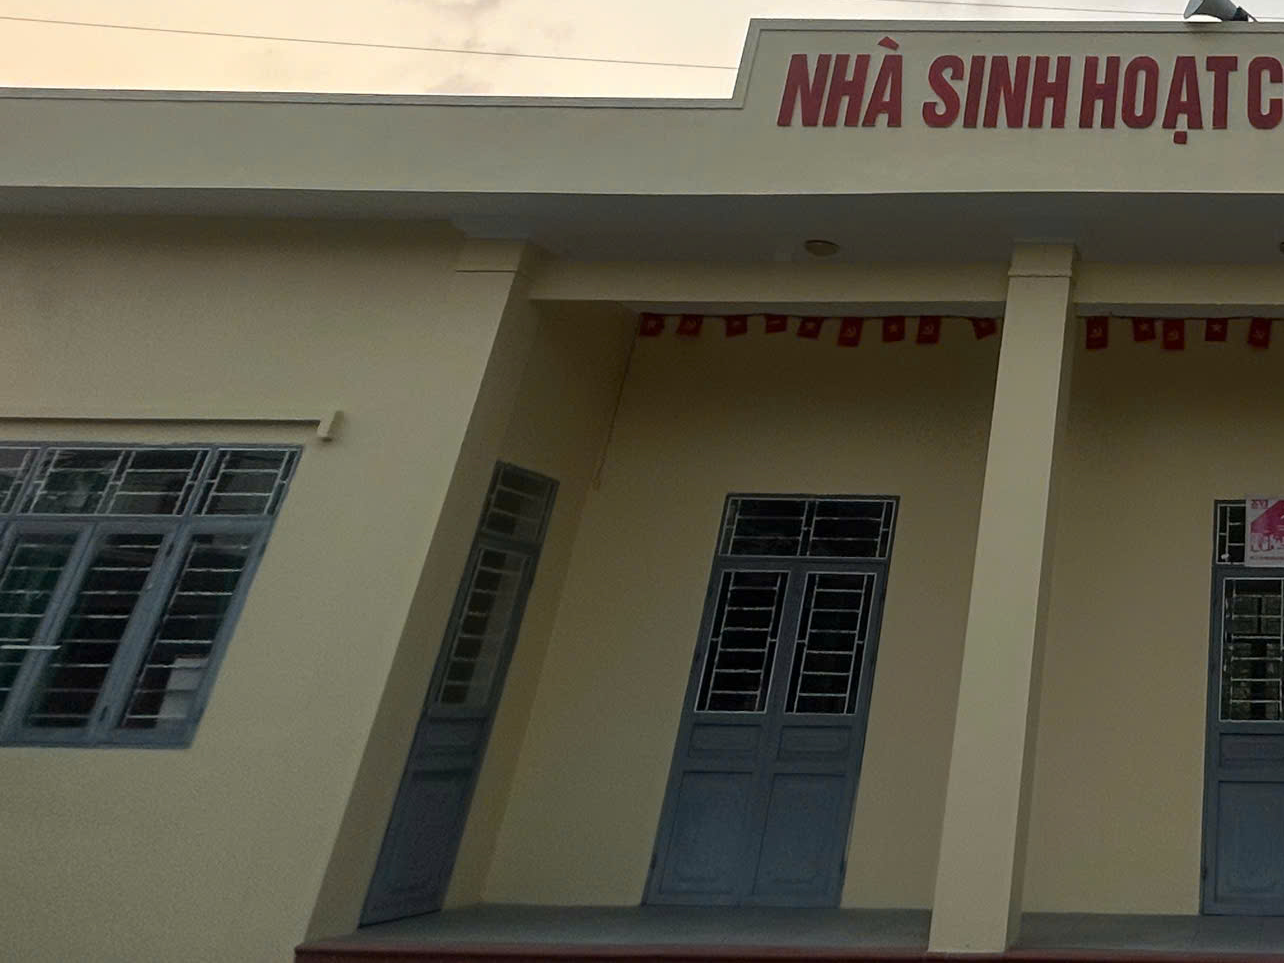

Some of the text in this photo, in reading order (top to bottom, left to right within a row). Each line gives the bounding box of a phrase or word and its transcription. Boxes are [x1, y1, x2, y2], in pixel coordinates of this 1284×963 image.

[777, 36, 903, 127] NHÀ
[922, 55, 1071, 128] SINH
[1079, 55, 1239, 145] HOẠT
